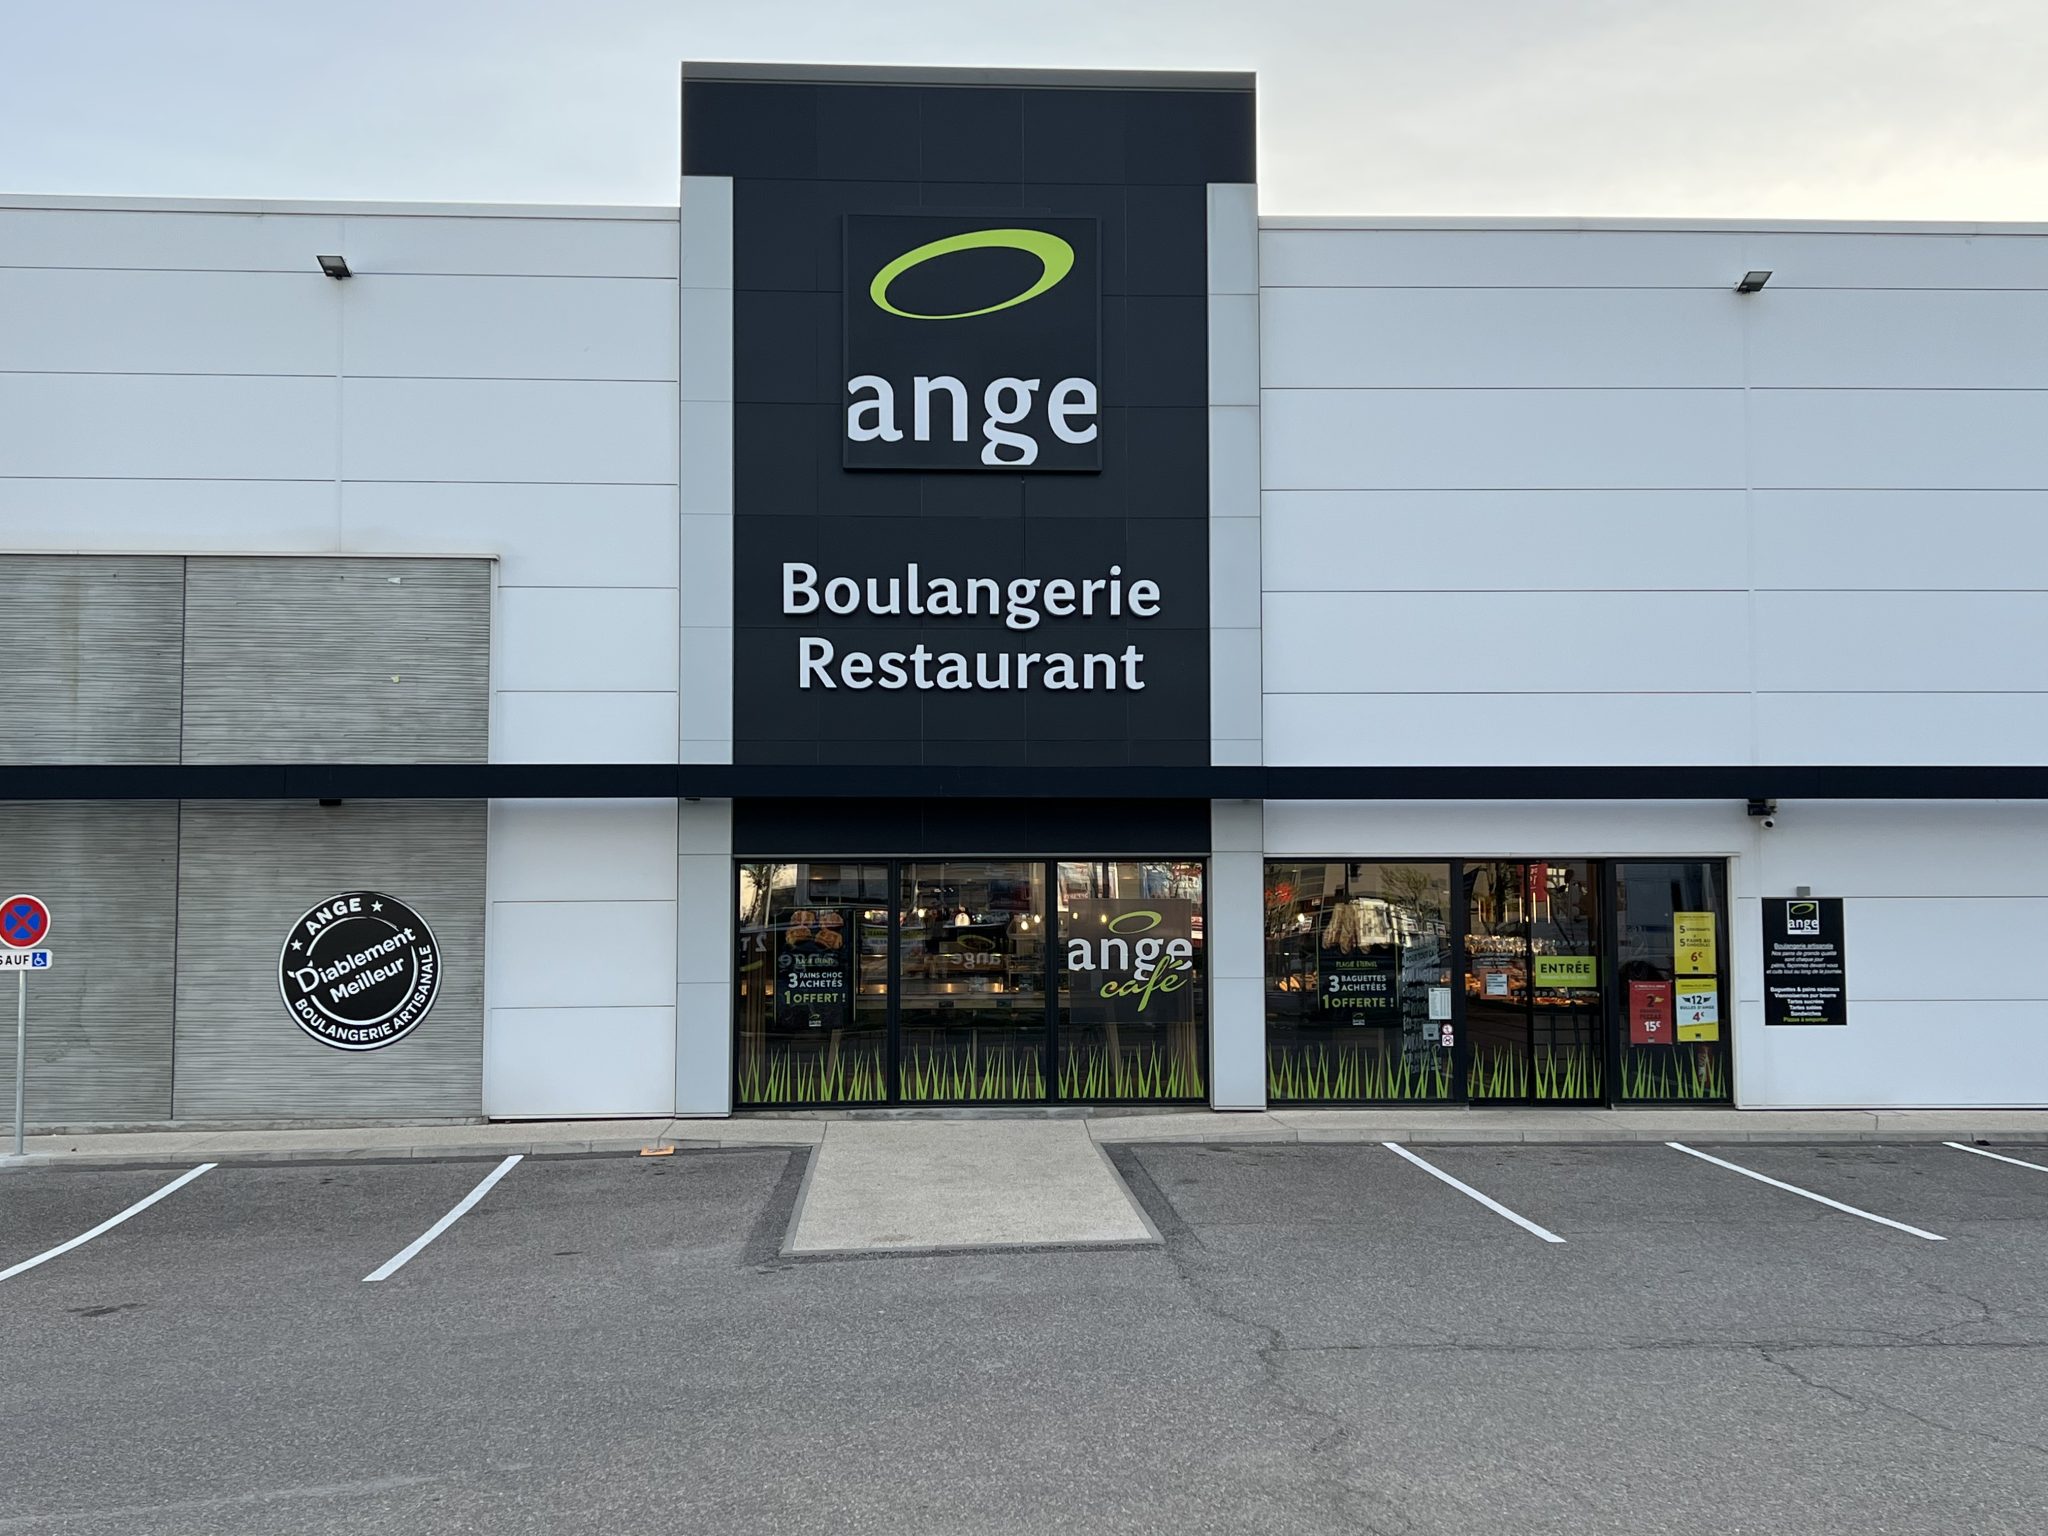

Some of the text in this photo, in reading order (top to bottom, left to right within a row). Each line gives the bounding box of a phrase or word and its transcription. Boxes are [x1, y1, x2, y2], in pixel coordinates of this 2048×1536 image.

[848, 374, 1098, 465] ange
[782, 562, 1161, 630] Boulangerie
[798, 636, 1146, 690] Restaurant
[305, 897, 362, 936] ANGE
[1679, 925, 1686, 934] 5
[1789, 919, 1819, 931] ange
[1679, 938, 1686, 947] 5
[290, 926, 417, 993] Diablement
[1067, 937, 1193, 981] ange
[1540, 960, 1590, 974] ENTRÉE
[329, 958, 405, 1003] Meilleur
[788, 972, 798, 988] 3
[799, 978, 843, 988] ACHETÉS
[1100, 955, 1188, 1012] café
[1328, 975, 1340, 992] 3
[1341, 982, 1387, 991] ACHETÉES
[295, 944, 434, 1041] BOULANGERIE ARTISANALE
[784, 990, 846, 1004] 1 OFFERT !
[1691, 995, 1702, 1005] 12
[1322, 994, 1394, 1009] 1 OFFERTE !
